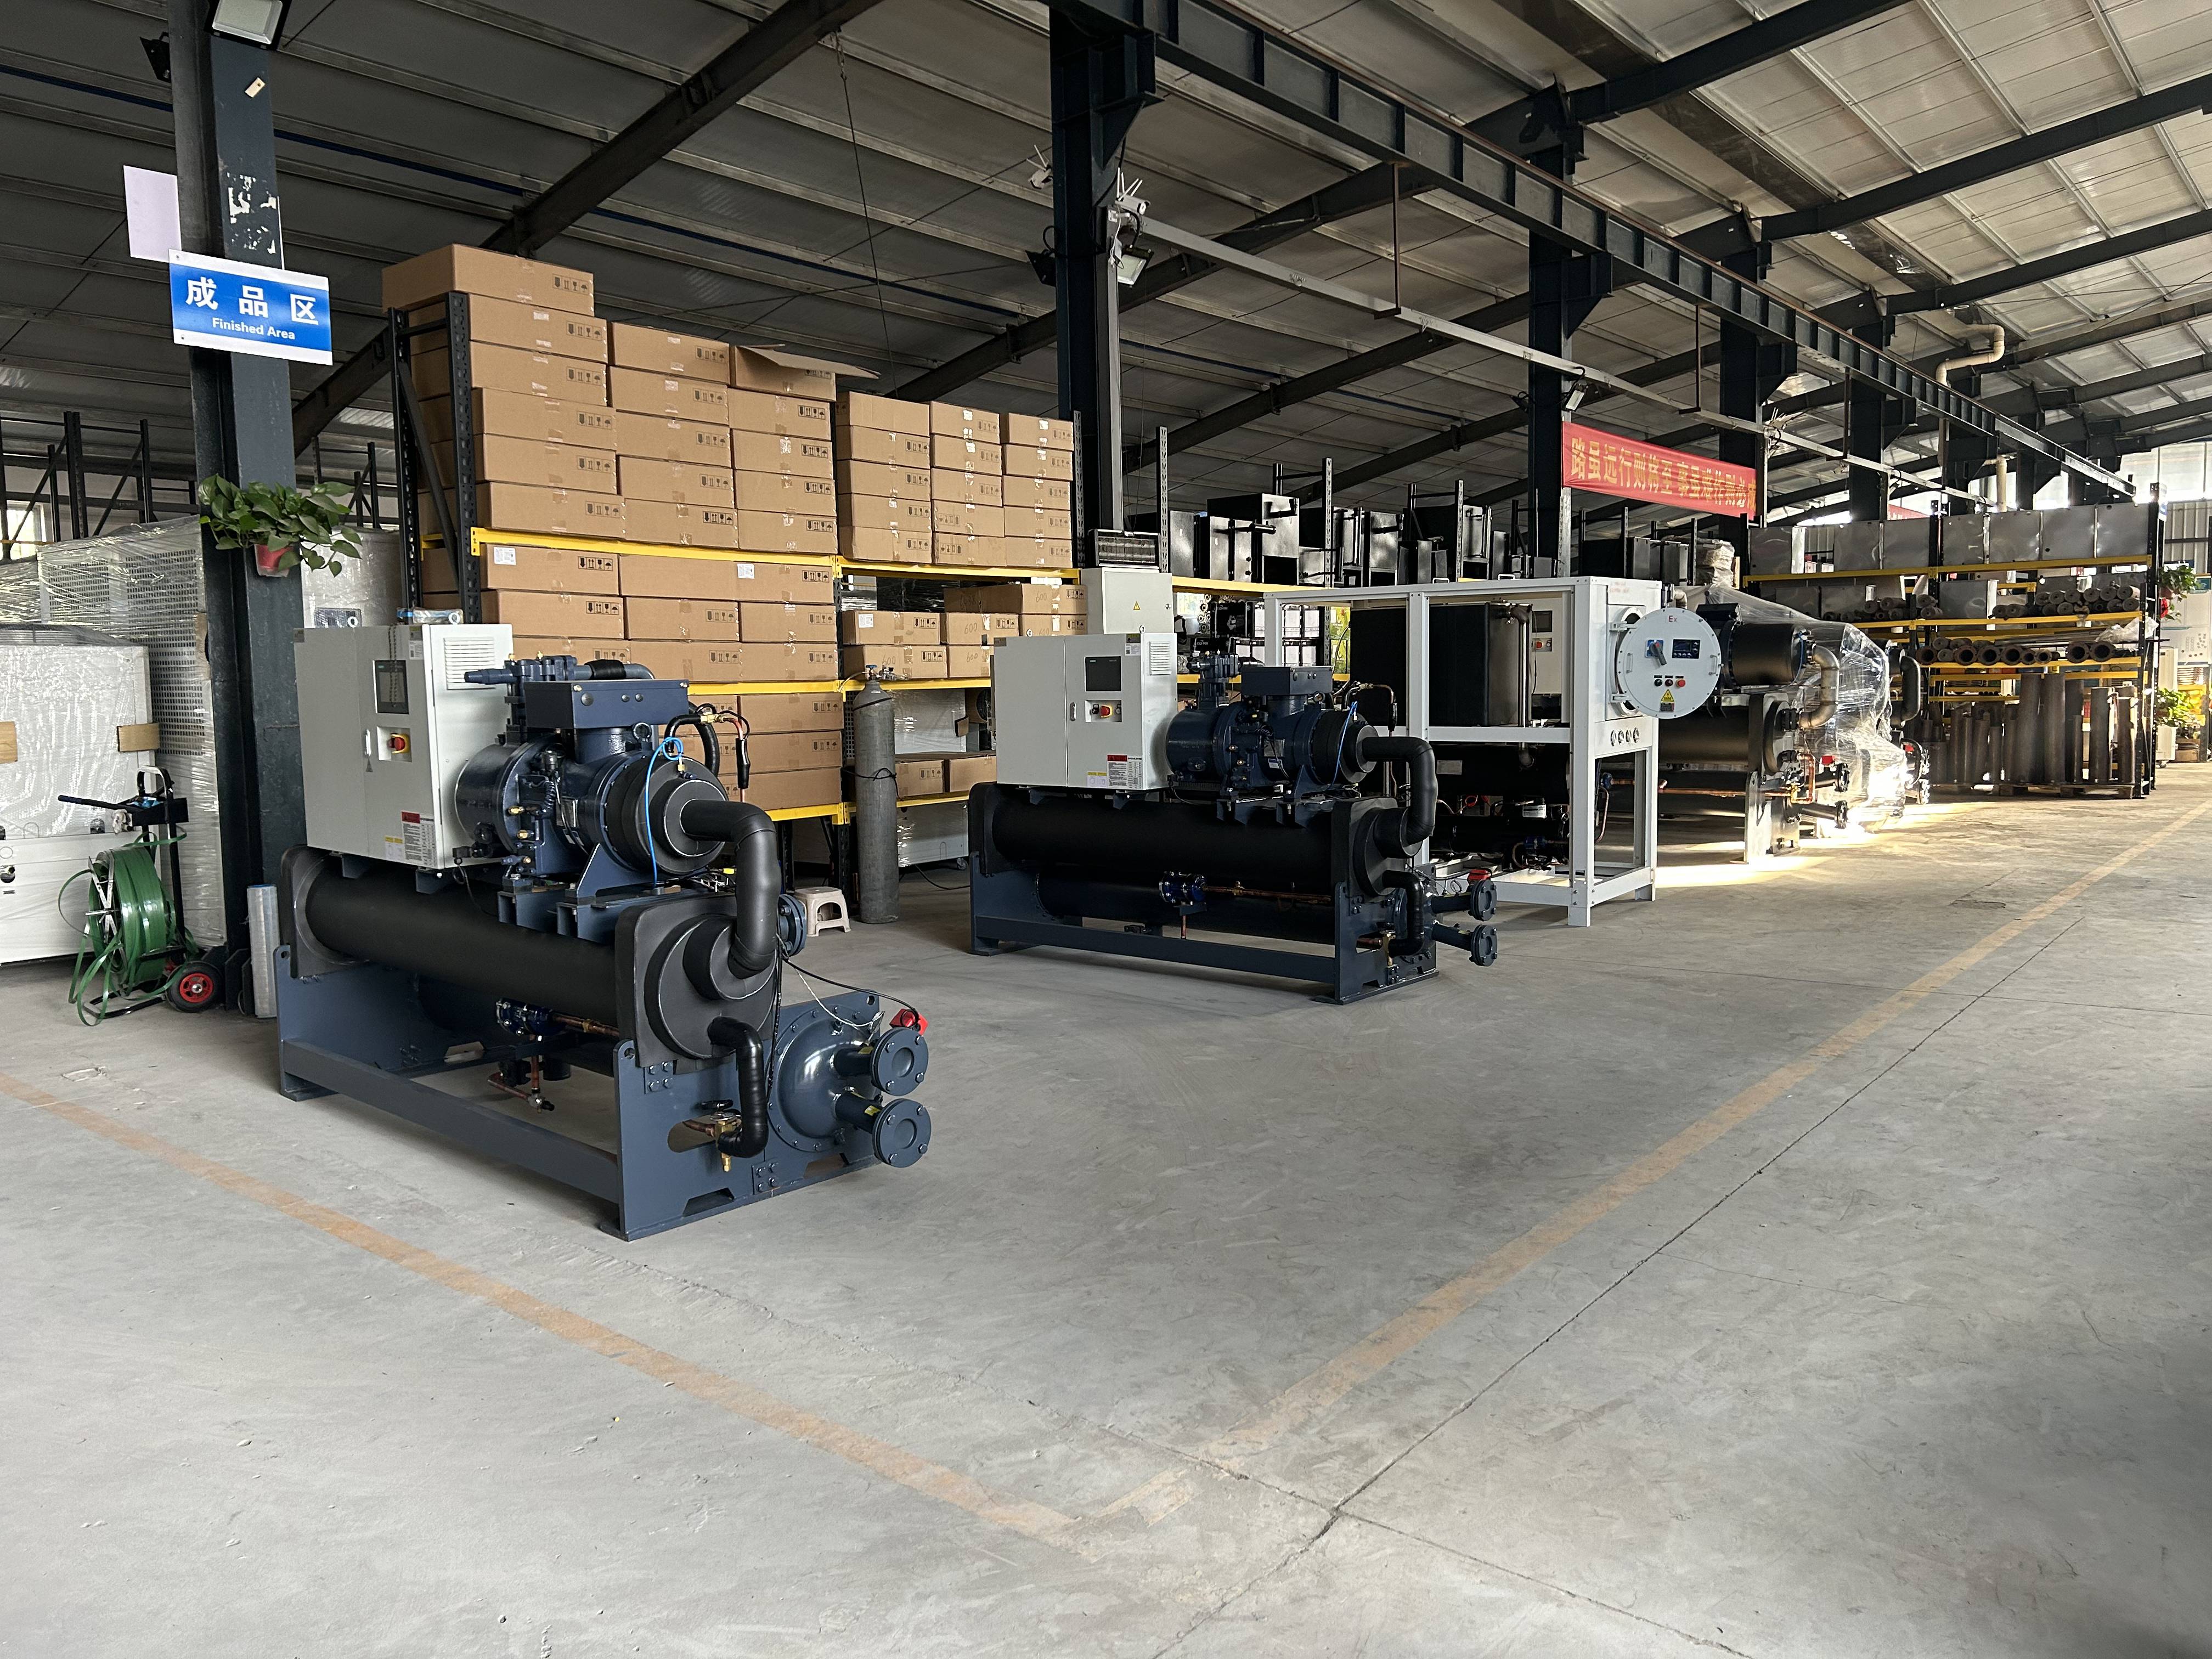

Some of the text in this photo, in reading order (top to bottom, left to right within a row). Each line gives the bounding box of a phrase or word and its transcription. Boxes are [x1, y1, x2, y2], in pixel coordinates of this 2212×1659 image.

[185, 276, 319, 325] 成品区
[212, 317, 296, 340] Finished Area
[1036, 592, 1047, 603] 600
[964, 622, 978, 634] 600
[882, 654, 896, 665] 600
[967, 652, 979, 662] 600
